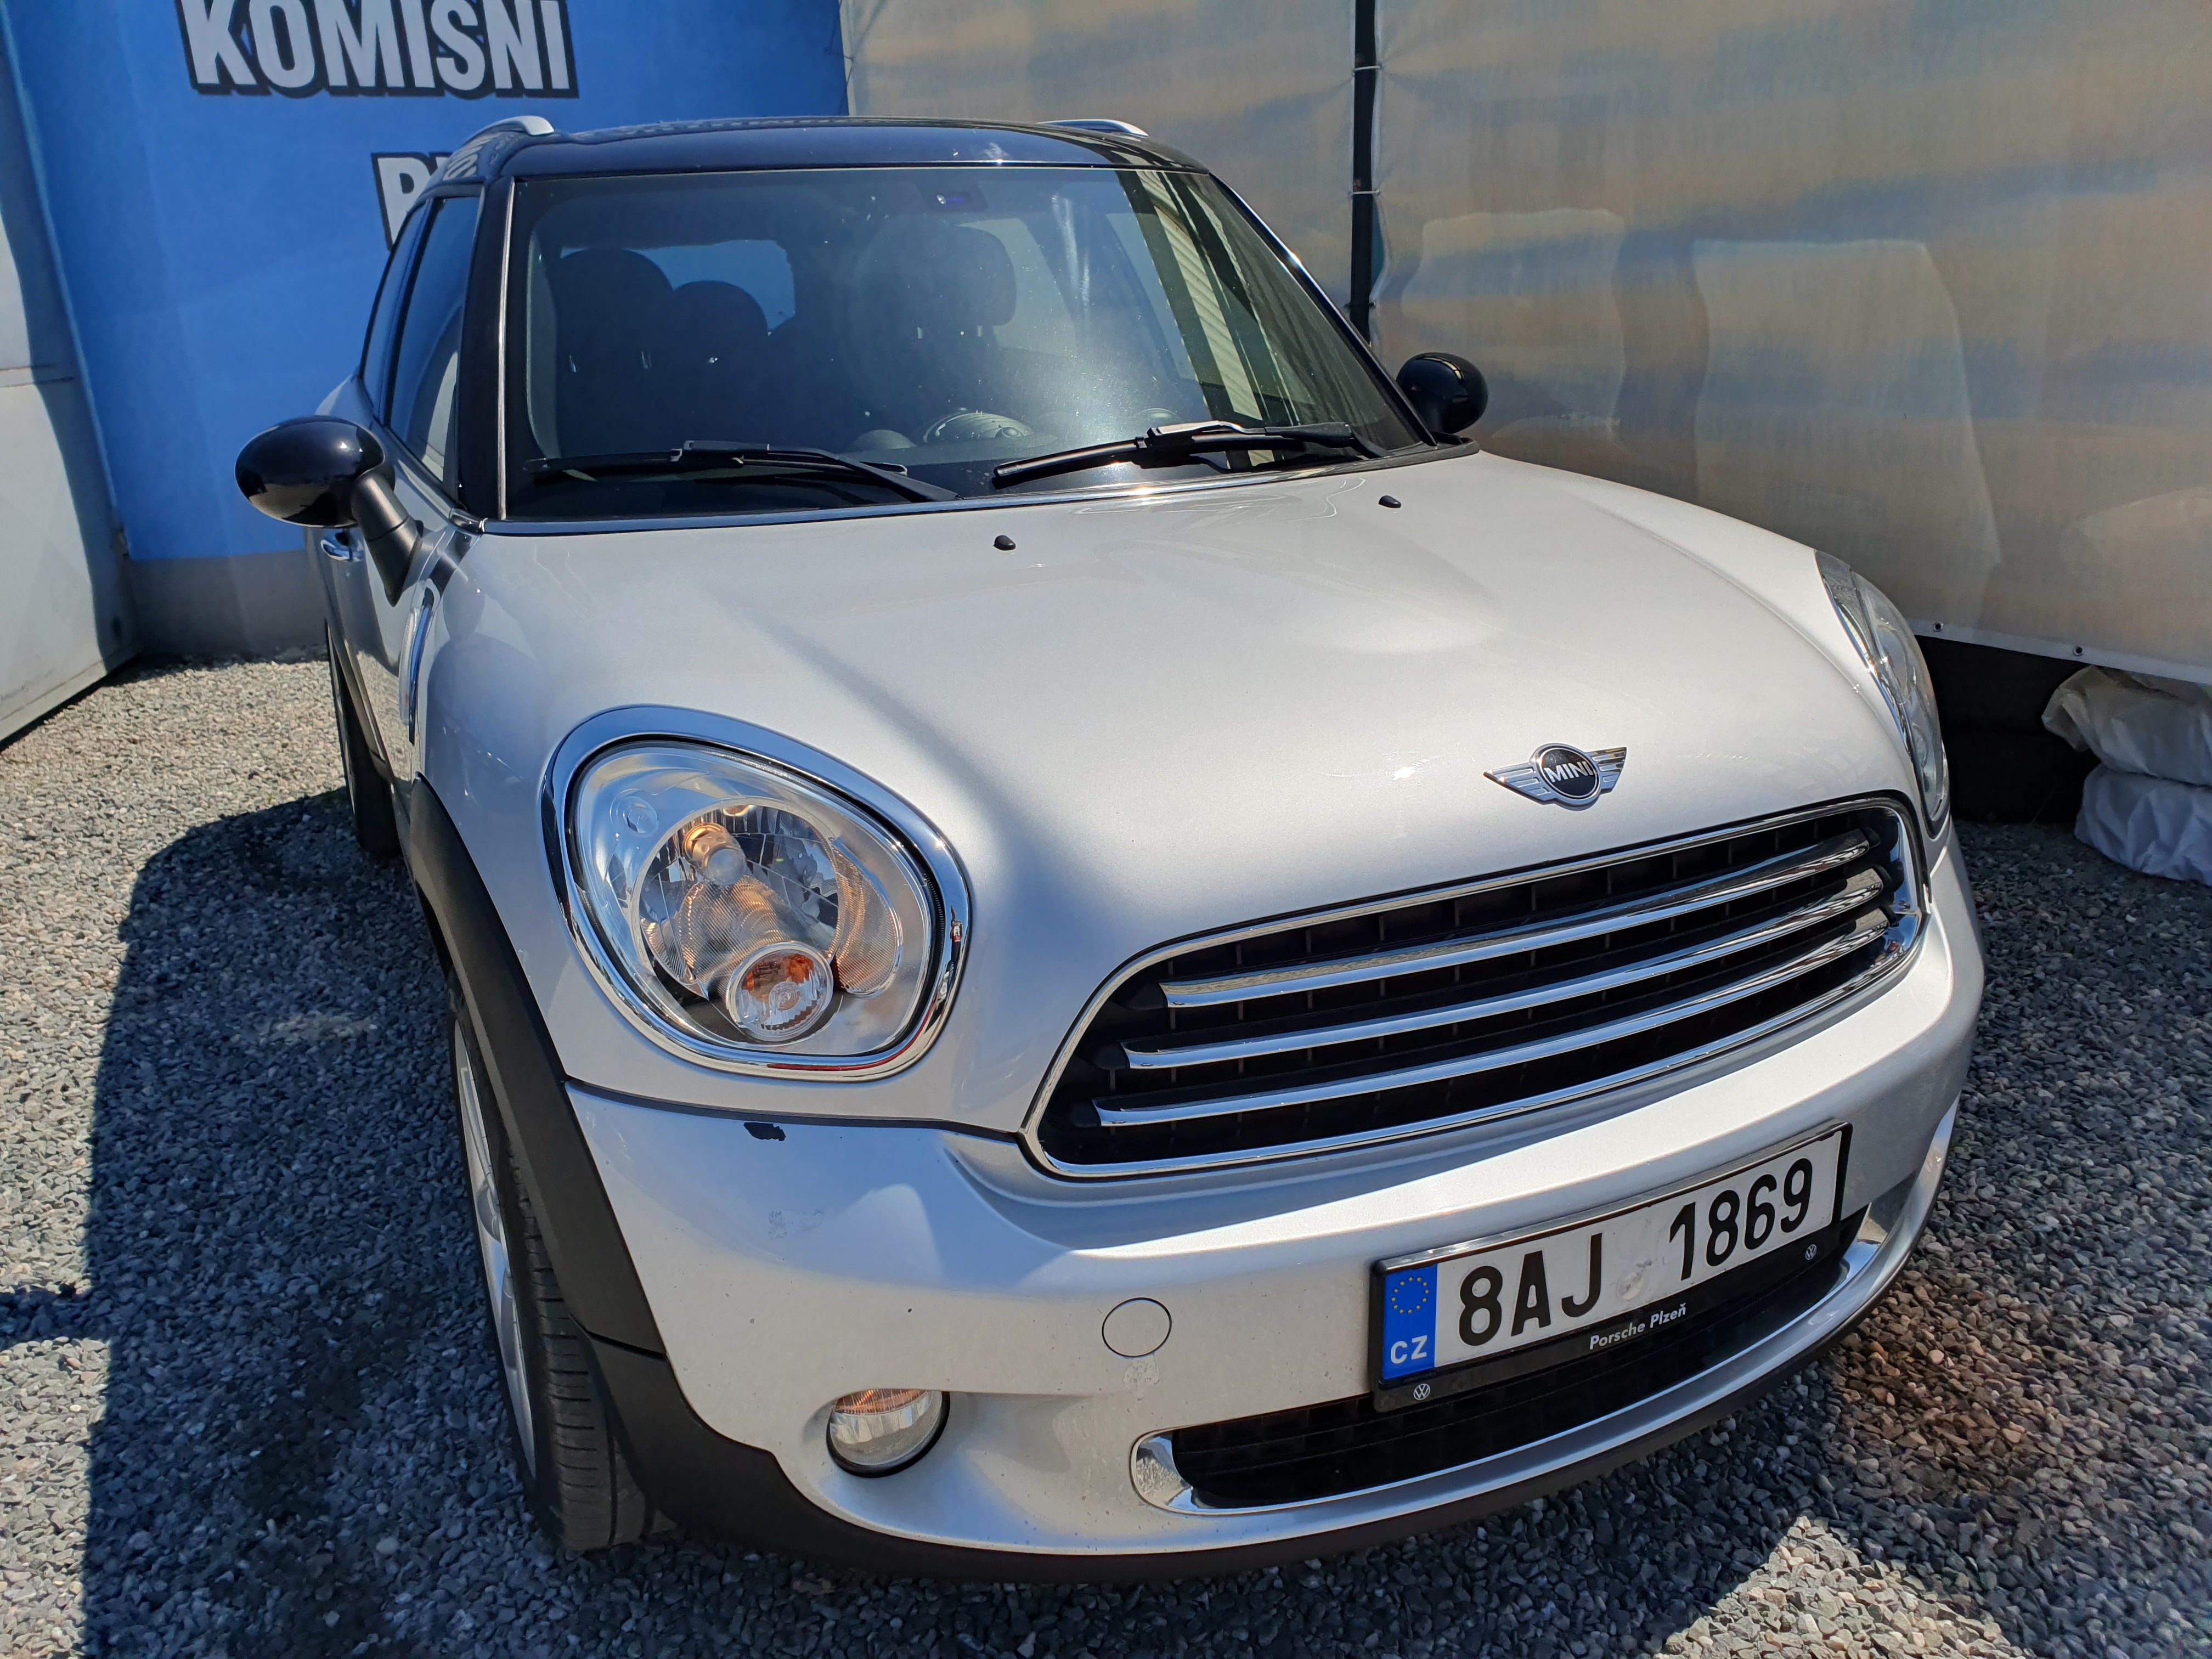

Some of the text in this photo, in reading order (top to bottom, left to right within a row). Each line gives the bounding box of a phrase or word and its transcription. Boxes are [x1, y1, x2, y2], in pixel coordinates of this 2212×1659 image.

[1543, 760, 1594, 783] MINI
[1458, 1157, 1813, 1347] 8AJ 1869
[1589, 1302, 1686, 1350] Porsche Plzeň
[1390, 1334, 1427, 1364] CZ
